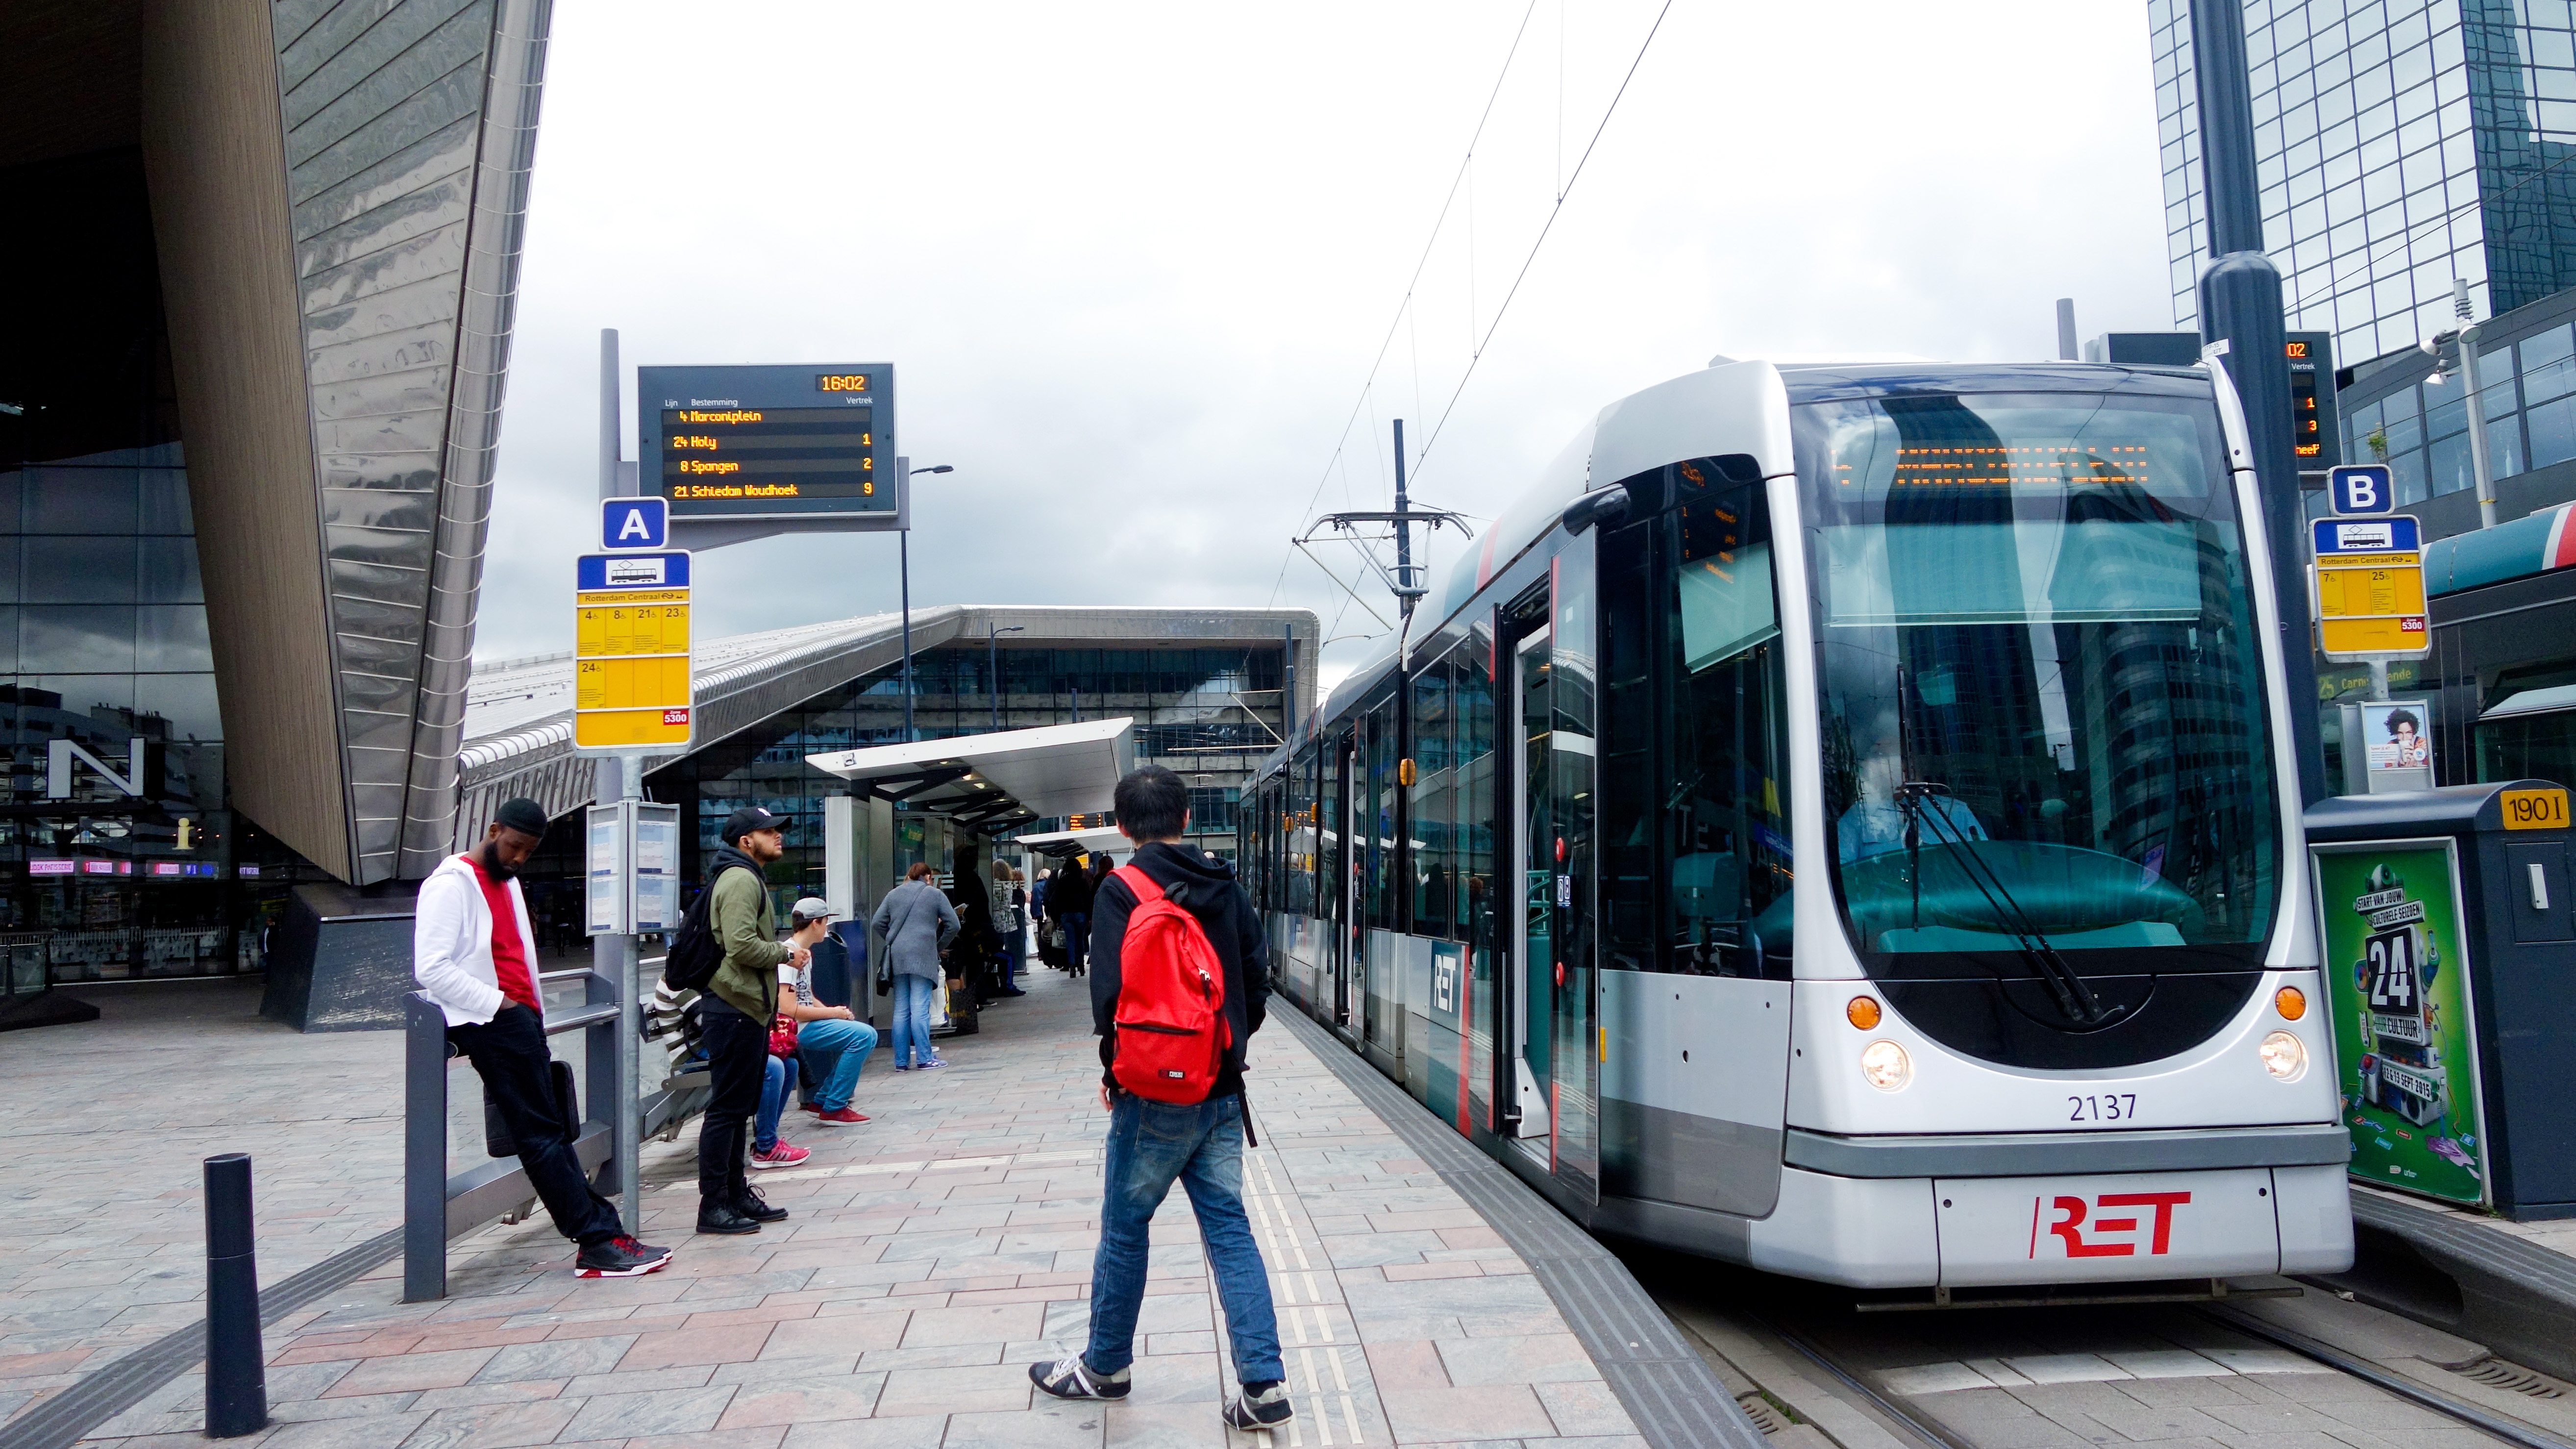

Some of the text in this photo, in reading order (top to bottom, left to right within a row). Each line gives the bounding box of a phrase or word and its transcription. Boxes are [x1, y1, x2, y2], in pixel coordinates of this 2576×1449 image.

[822, 375, 865, 391] 16:02
[665, 396, 873, 408] Lijn Bestemming Vertrek
[2307, 398, 2315, 408] 1
[680, 410, 762, 424] 4 Marconiplein
[2309, 420, 2317, 431] 3
[673, 434, 870, 450] 24 Holy 1
[680, 459, 871, 475] 8 Spangen 2
[674, 483, 872, 497] 21 Schiedam Woudhoek 9
[2348, 475, 2377, 508] B
[619, 509, 650, 540] A
[2324, 574, 2329, 582] 7
[2372, 572, 2384, 580] 25
[585, 611, 592, 620] 4
[614, 610, 620, 619] 8
[638, 609, 650, 618] 21
[666, 608, 679, 617] 23
[2402, 622, 2422, 630] 5300
[582, 663, 595, 672] 24
[2319, 675, 2334, 700] 25
[665, 714, 687, 723] 5300
[2509, 797, 2549, 822] 190
[2358, 890, 2402, 908] START VAN JOUW
[2373, 903, 2420, 925] CULTURELE SEIZOEN
[2370, 936, 2410, 1006] 24
[1434, 954, 1456, 1013] RET
[2375, 1016, 2418, 1039] UUR CULTUUR
[2384, 1067, 2390, 1078] 12
[2394, 1071, 2400, 1083] 13
[2401, 1074, 2413, 1091] SEPT
[2415, 1079, 2430, 1098] 2015
[2068, 1094, 2136, 1121] 2137
[2029, 1191, 2191, 1259] RET
